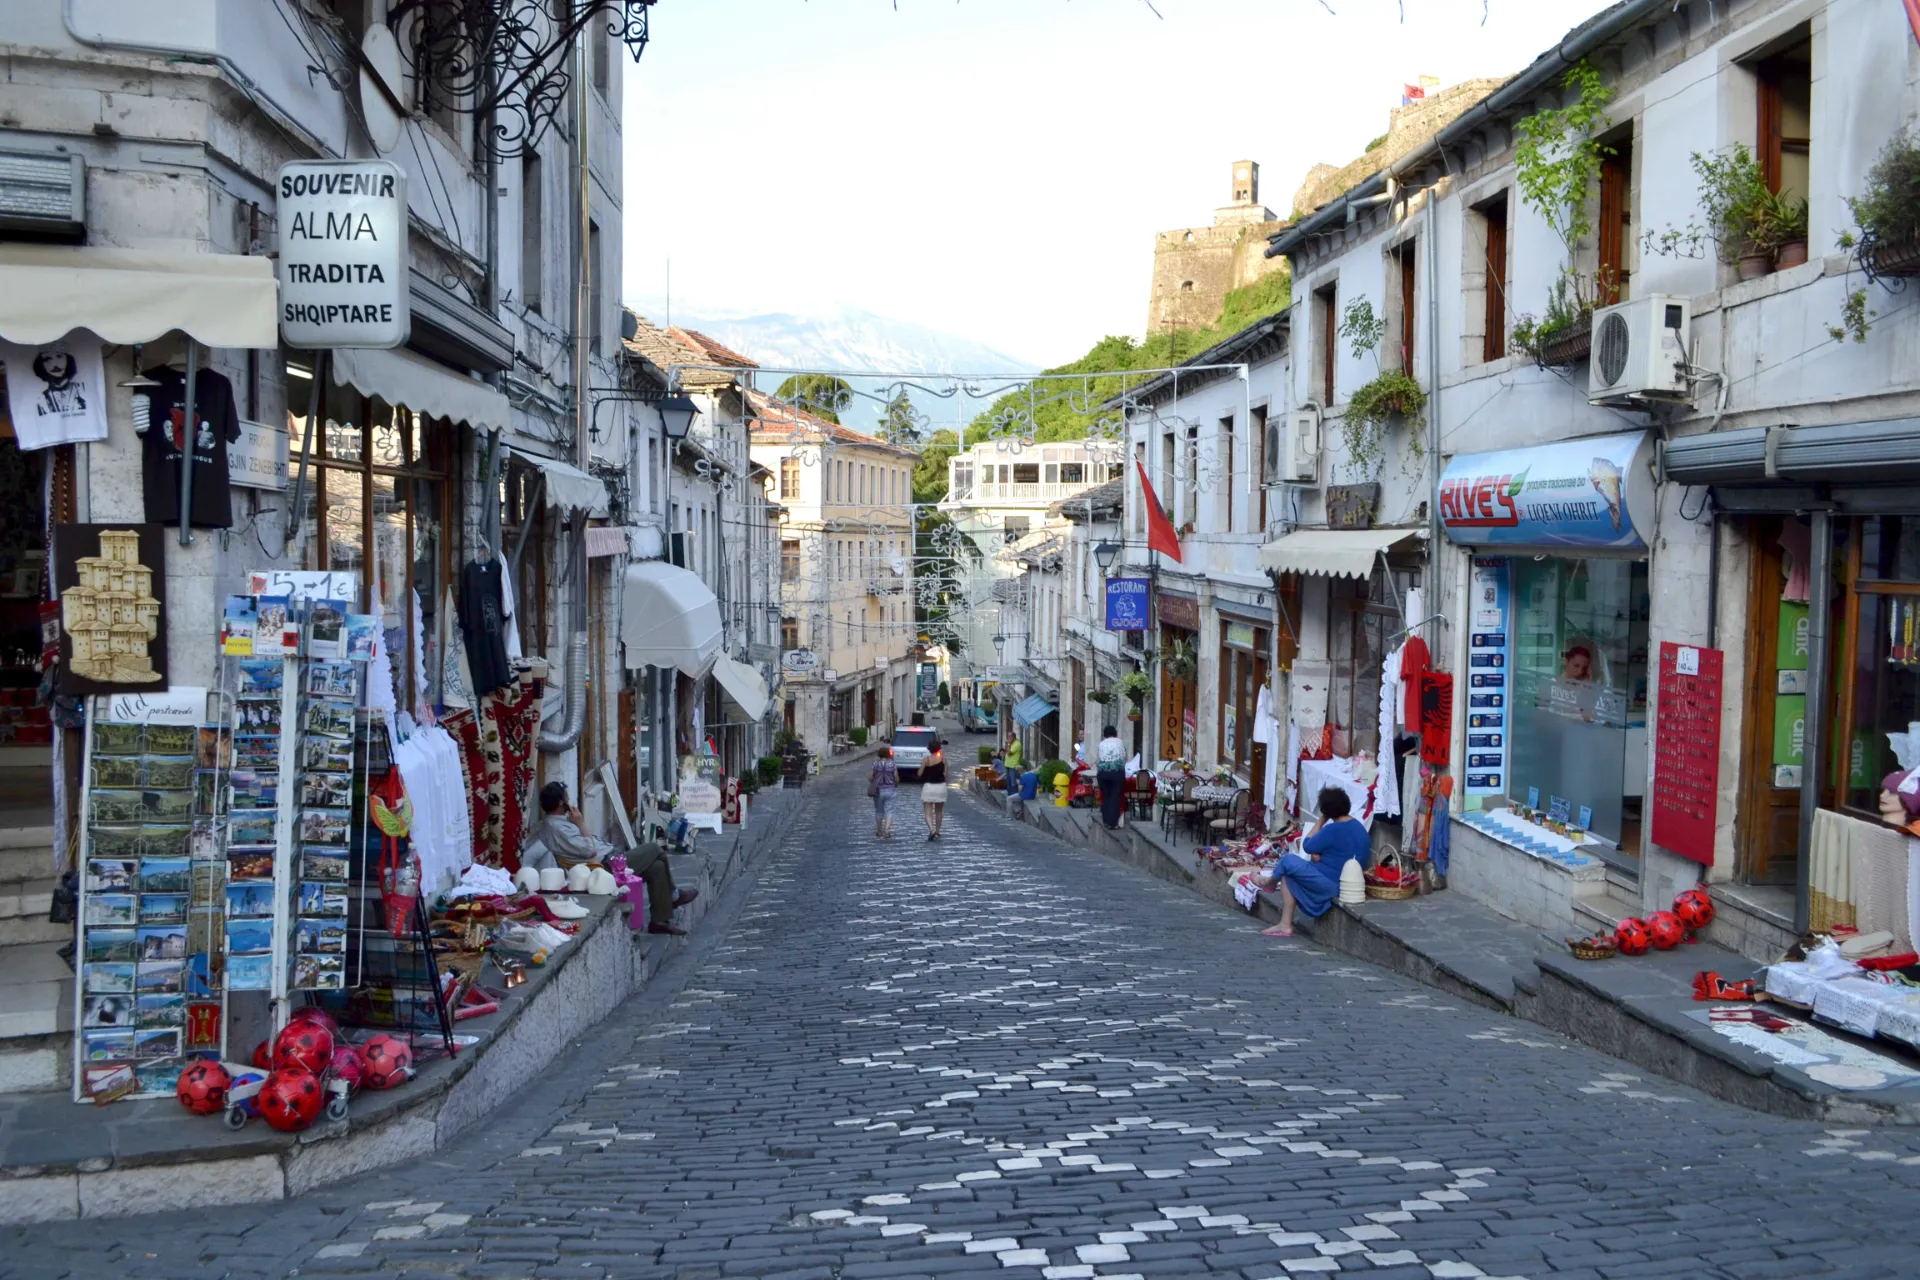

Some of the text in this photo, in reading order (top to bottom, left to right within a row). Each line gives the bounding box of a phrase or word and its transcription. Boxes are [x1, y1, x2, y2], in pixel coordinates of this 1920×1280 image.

[281, 173, 395, 199] SOUVENIR
[290, 211, 377, 241] ALMA
[288, 263, 385, 283] TRADITA
[285, 303, 392, 326] SHQIPTARE
[1440, 474, 1518, 527] RIVE'S
[1527, 501, 1600, 525] LIQENI OHRIT
[1108, 581, 1147, 594] RESTORANT
[697, 758, 716, 767] HYR
